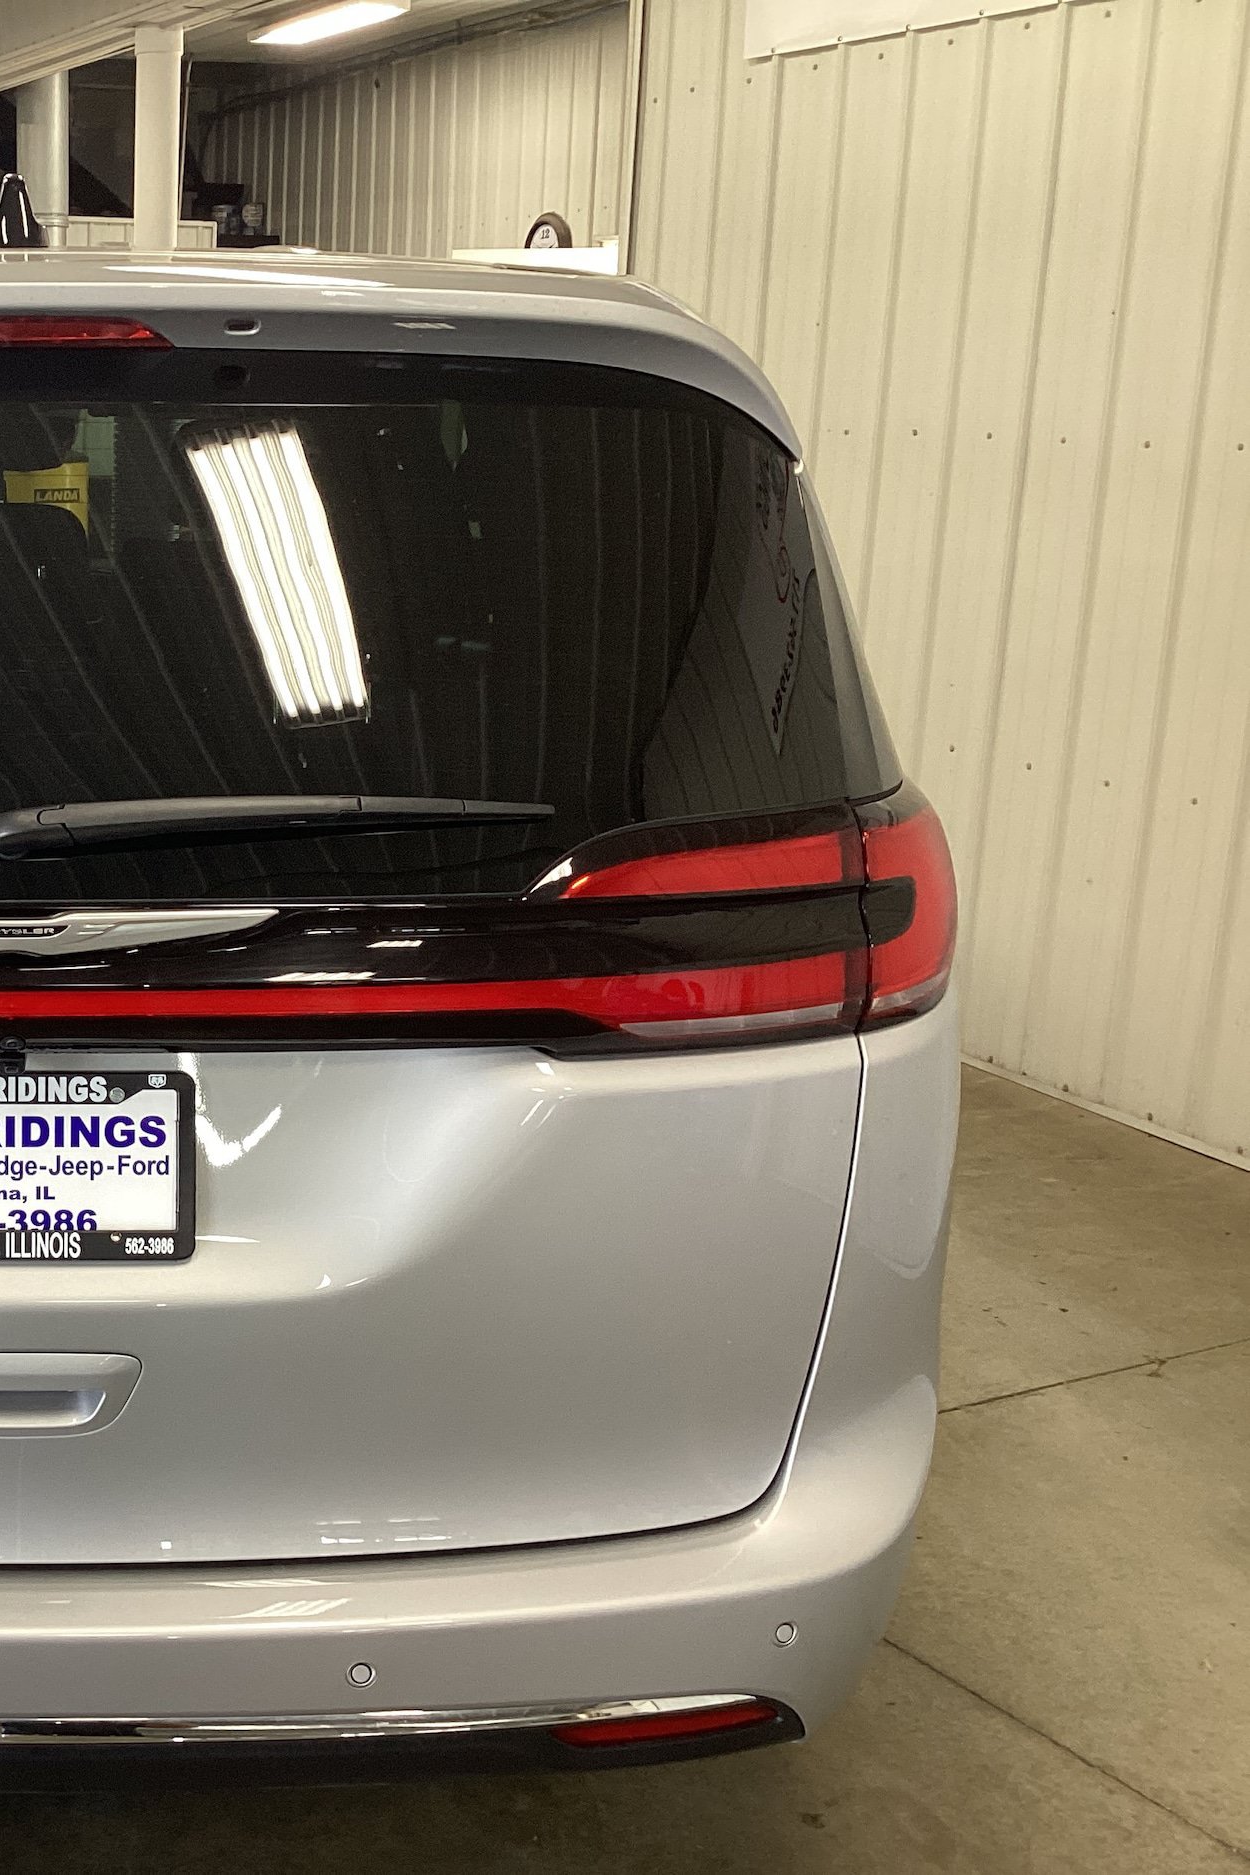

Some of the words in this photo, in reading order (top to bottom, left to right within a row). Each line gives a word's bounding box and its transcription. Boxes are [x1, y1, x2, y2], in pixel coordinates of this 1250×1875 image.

[541, 228, 551, 239] 12
[35, 1186, 56, 1200] IL
[5, 1231, 82, 1259] ILLINOIS
[125, 1237, 174, 1255] 562-3986
